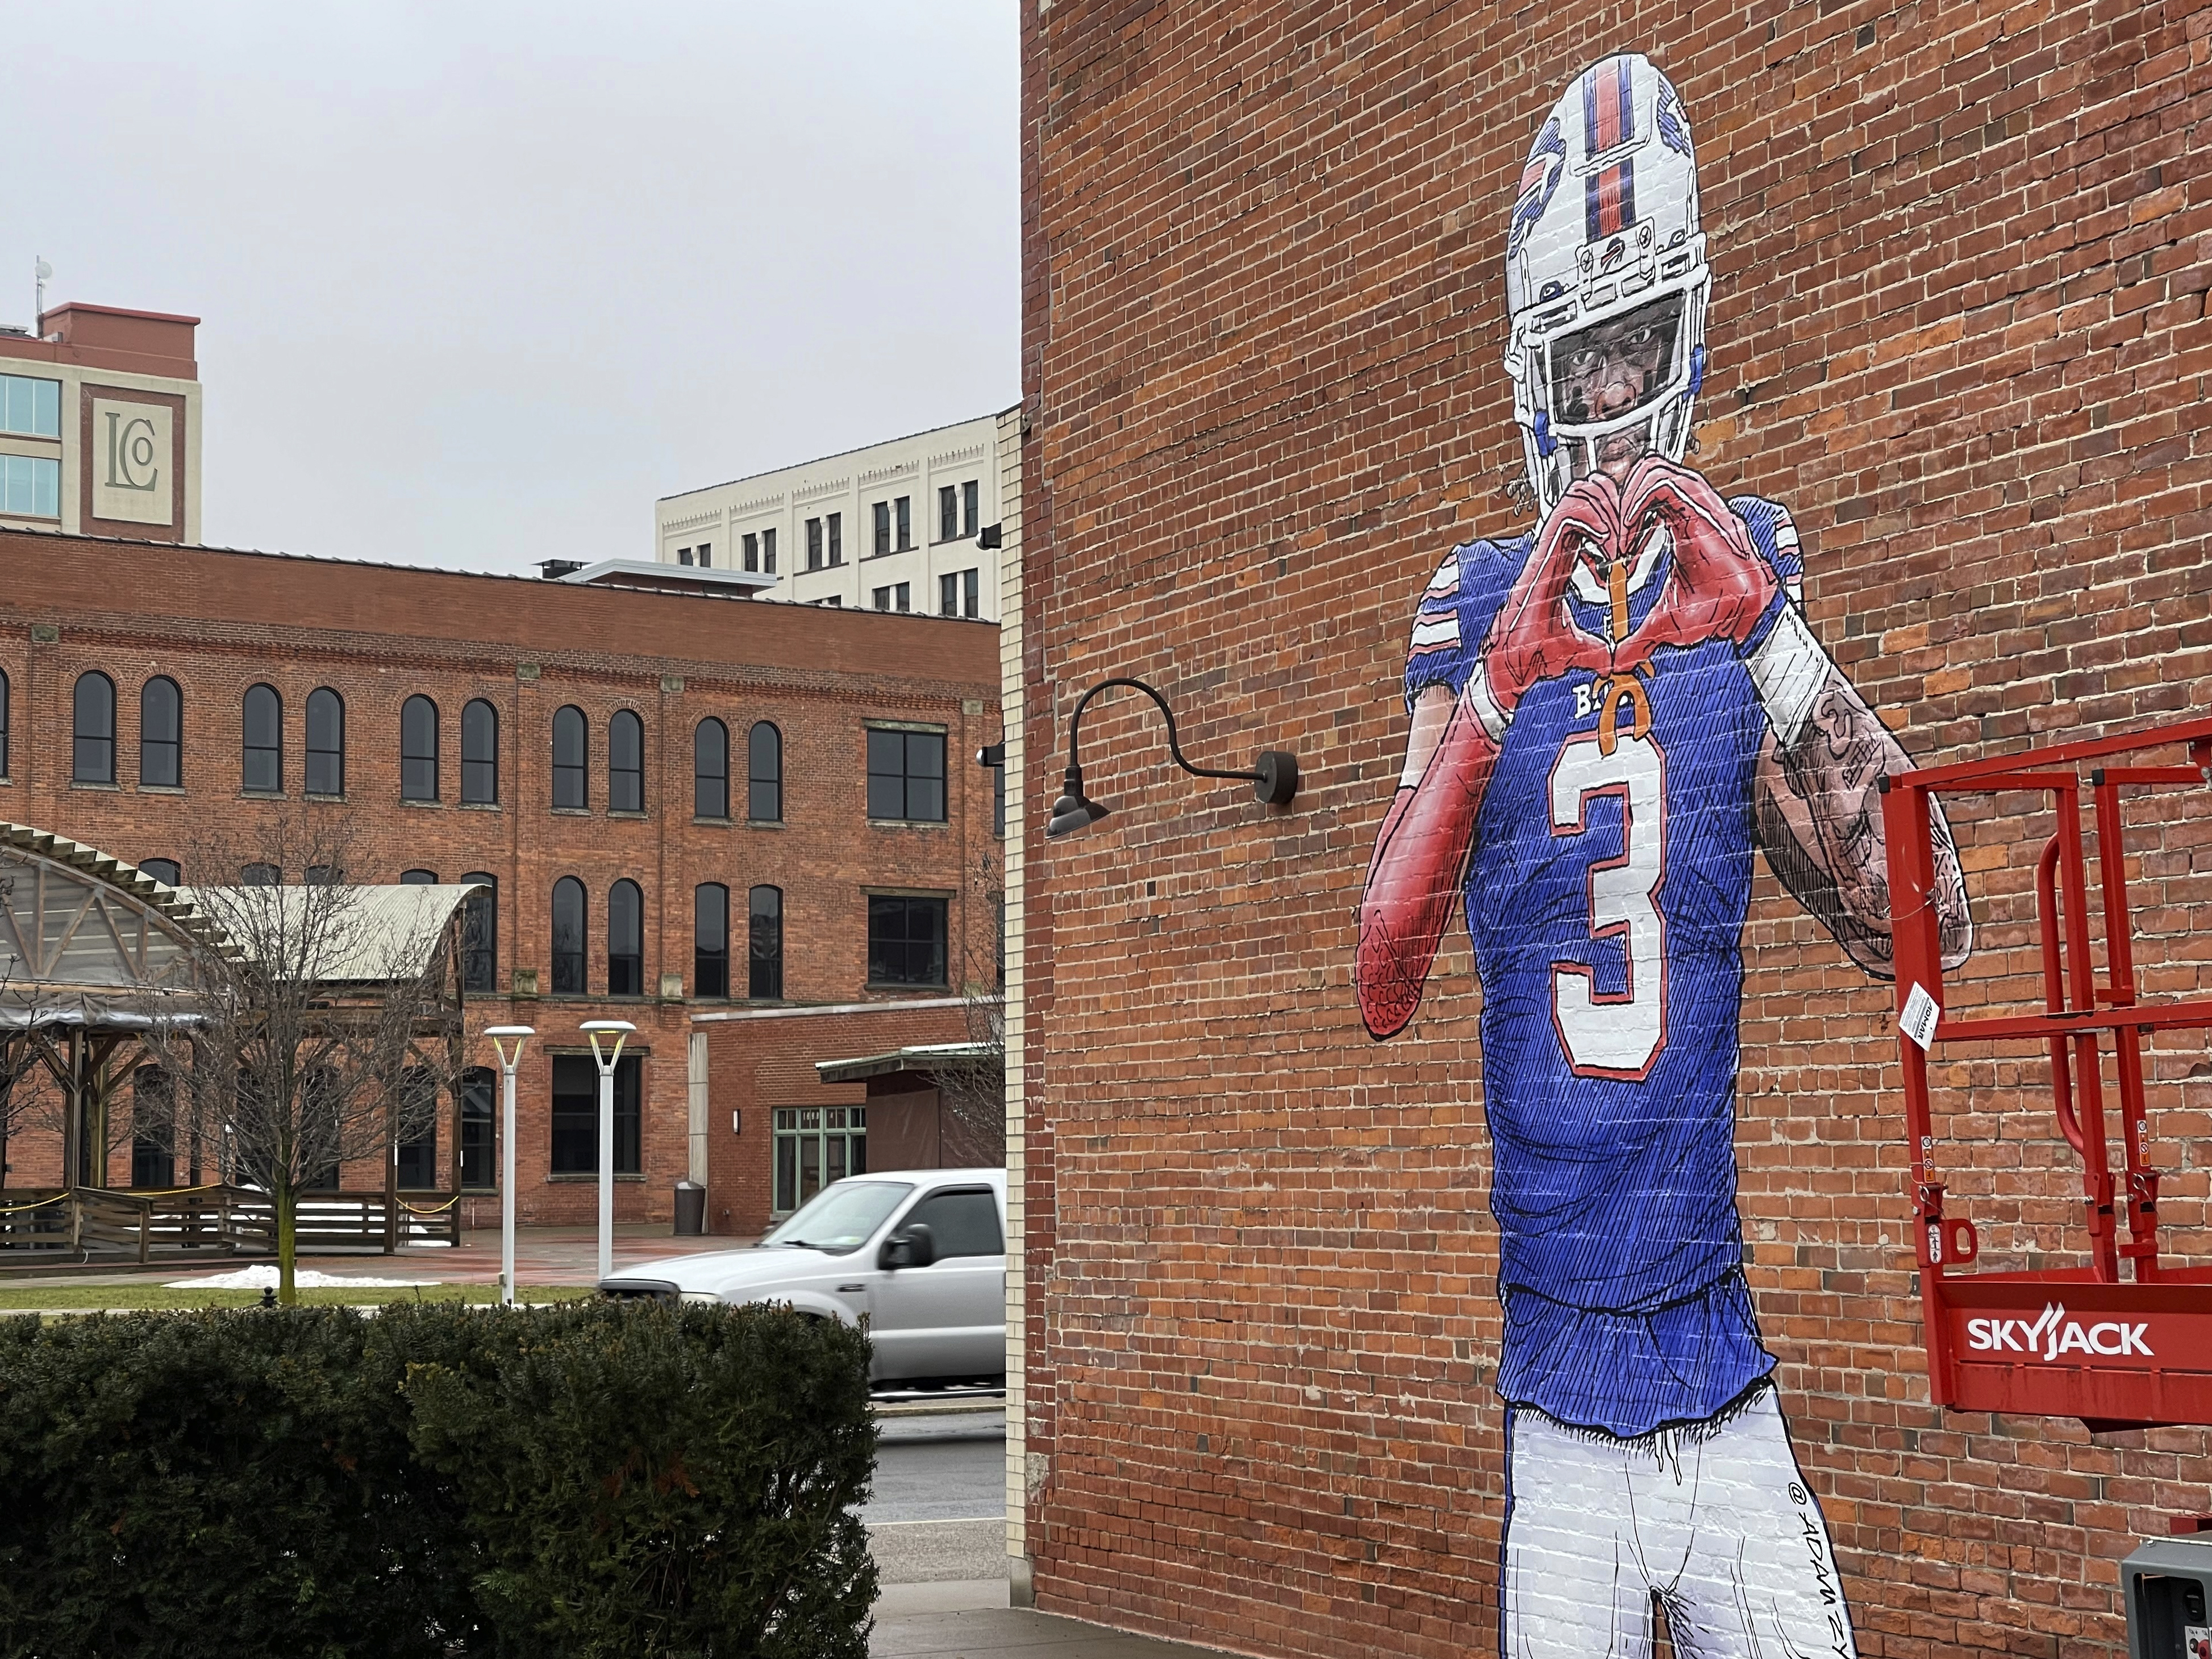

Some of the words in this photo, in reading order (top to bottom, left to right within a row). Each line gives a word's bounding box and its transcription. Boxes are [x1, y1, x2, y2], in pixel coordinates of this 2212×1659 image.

[1547, 726, 1668, 1083] 3
[1918, 1002, 1933, 1040] ADMAR
[1967, 1301, 2155, 1361] SKYJACK
